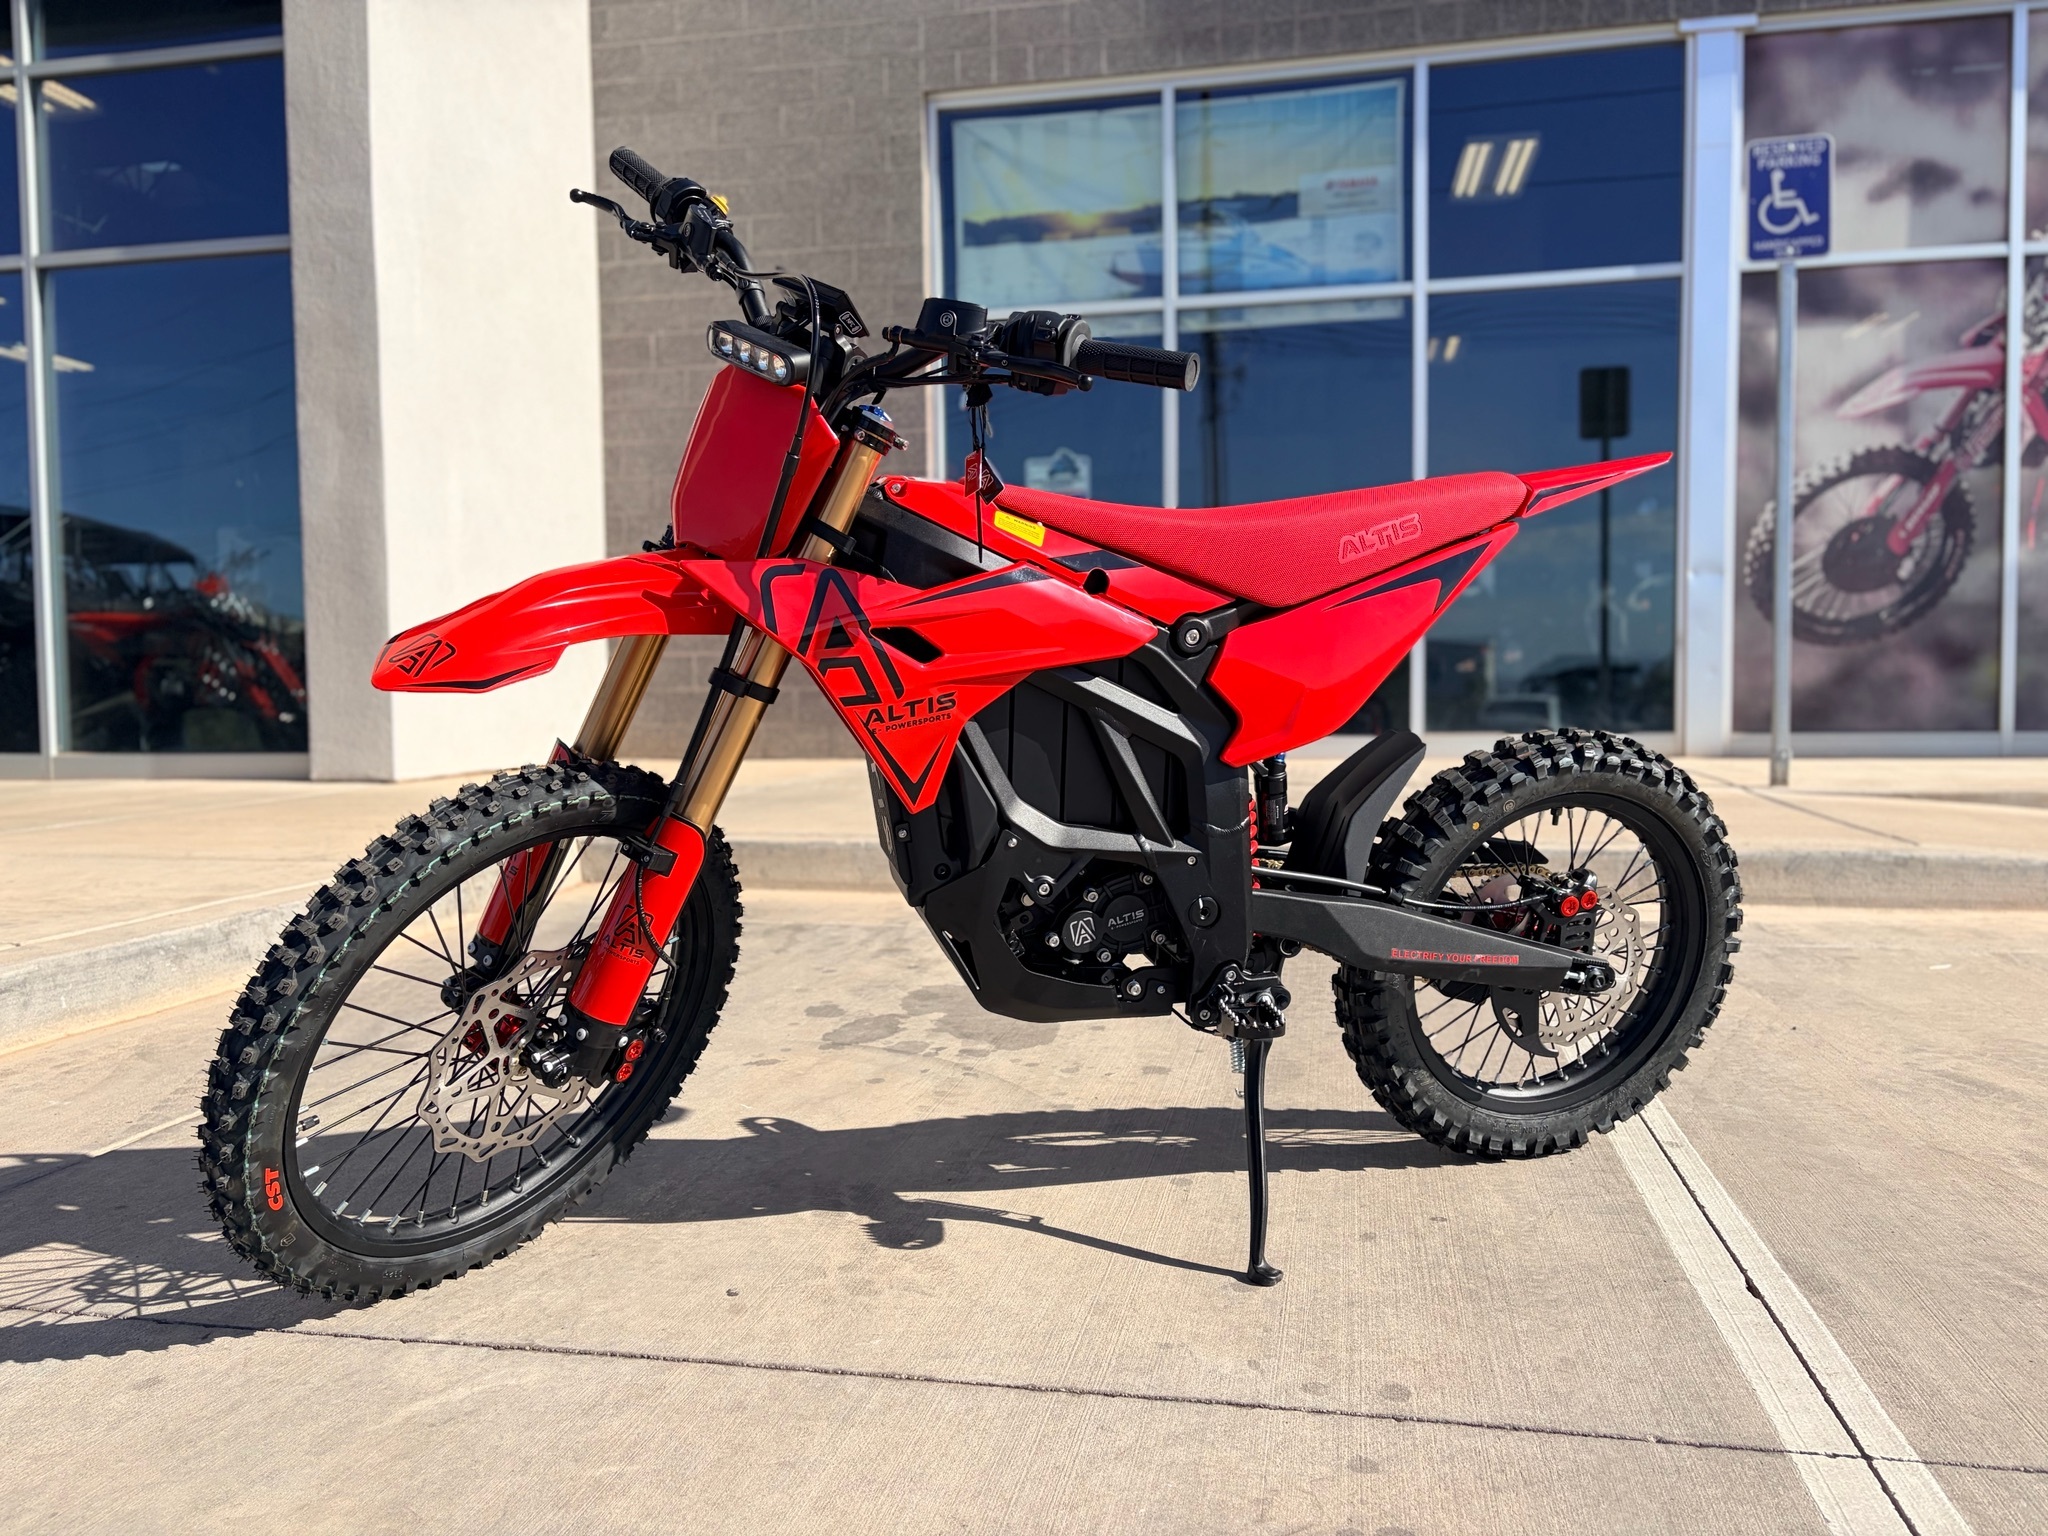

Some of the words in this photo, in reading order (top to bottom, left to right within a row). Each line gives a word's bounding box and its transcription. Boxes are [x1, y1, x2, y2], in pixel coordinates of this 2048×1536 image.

[1757, 154, 1822, 171] PARKING
[1342, 515, 1418, 560] ALTIS
[864, 691, 957, 727] ALTIS
[885, 713, 951, 732] POWERSPORTS
[1107, 908, 1145, 927] ALTIS
[603, 934, 646, 959] ALTIS
[1391, 947, 1444, 961] ELECTRIFY
[1446, 952, 1472, 963] YOUR
[265, 1167, 284, 1211] CST
